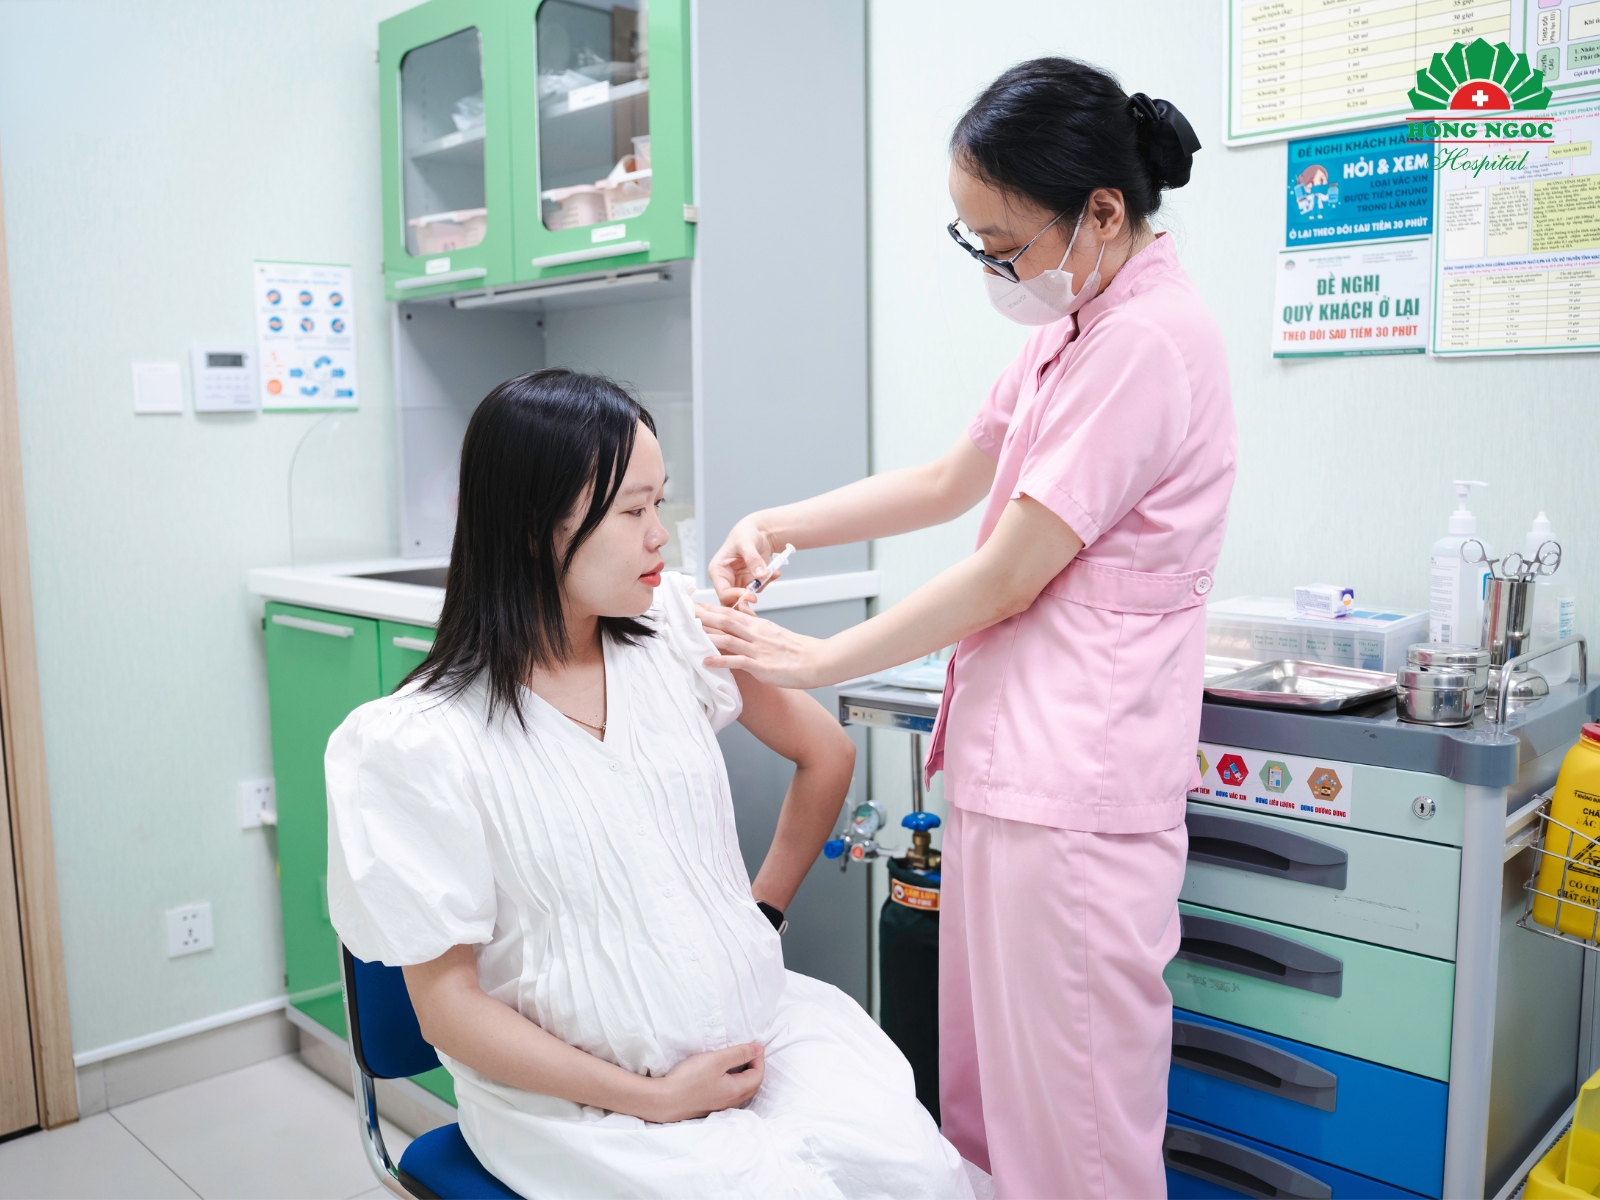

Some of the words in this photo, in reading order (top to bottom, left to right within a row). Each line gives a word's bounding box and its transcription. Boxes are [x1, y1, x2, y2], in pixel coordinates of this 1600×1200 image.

[1315, 143, 1342, 156] NGHỊ
[1346, 136, 1386, 152] KHÁCH
[1343, 156, 1373, 179] HỎI
[1377, 159, 1389, 174] &
[1392, 153, 1428, 173] XEM
[1370, 178, 1391, 188] LOẠI
[1412, 174, 1428, 183] XIN
[1344, 191, 1370, 203] ĐƯỢC
[1372, 189, 1394, 200] TIÊM
[1357, 203, 1387, 213] TRONG
[1390, 198, 1407, 209] LẦN
[1409, 197, 1428, 207] NÀY
[1289, 229, 1296, 239] Ở
[1298, 229, 1311, 239] LẠI
[1313, 227, 1335, 236] THEO
[1337, 224, 1352, 235] DÕI
[1354, 224, 1370, 233] SAU
[1372, 220, 1392, 231] TIÊM
[1393, 220, 1403, 229] 30
[1405, 216, 1428, 228] PHÚT
[1317, 272, 1336, 296] ĐỀ
[1341, 274, 1380, 296] NGHỊ
[1283, 302, 1313, 324] QUÝ
[1319, 299, 1373, 321] KHÁCH
[1379, 295, 1390, 318] Ở
[1396, 298, 1420, 320] LẠI
[1283, 330, 1306, 341] THEO
[1309, 329, 1326, 340] DÕI
[1329, 328, 1346, 339] SAU
[1350, 326, 1372, 339] TIÊM
[1376, 327, 1388, 337] 30
[1392, 324, 1418, 336] PHÚT
[1569, 880, 1583, 889] CÓ
[1580, 896, 1598, 906] GÂY
